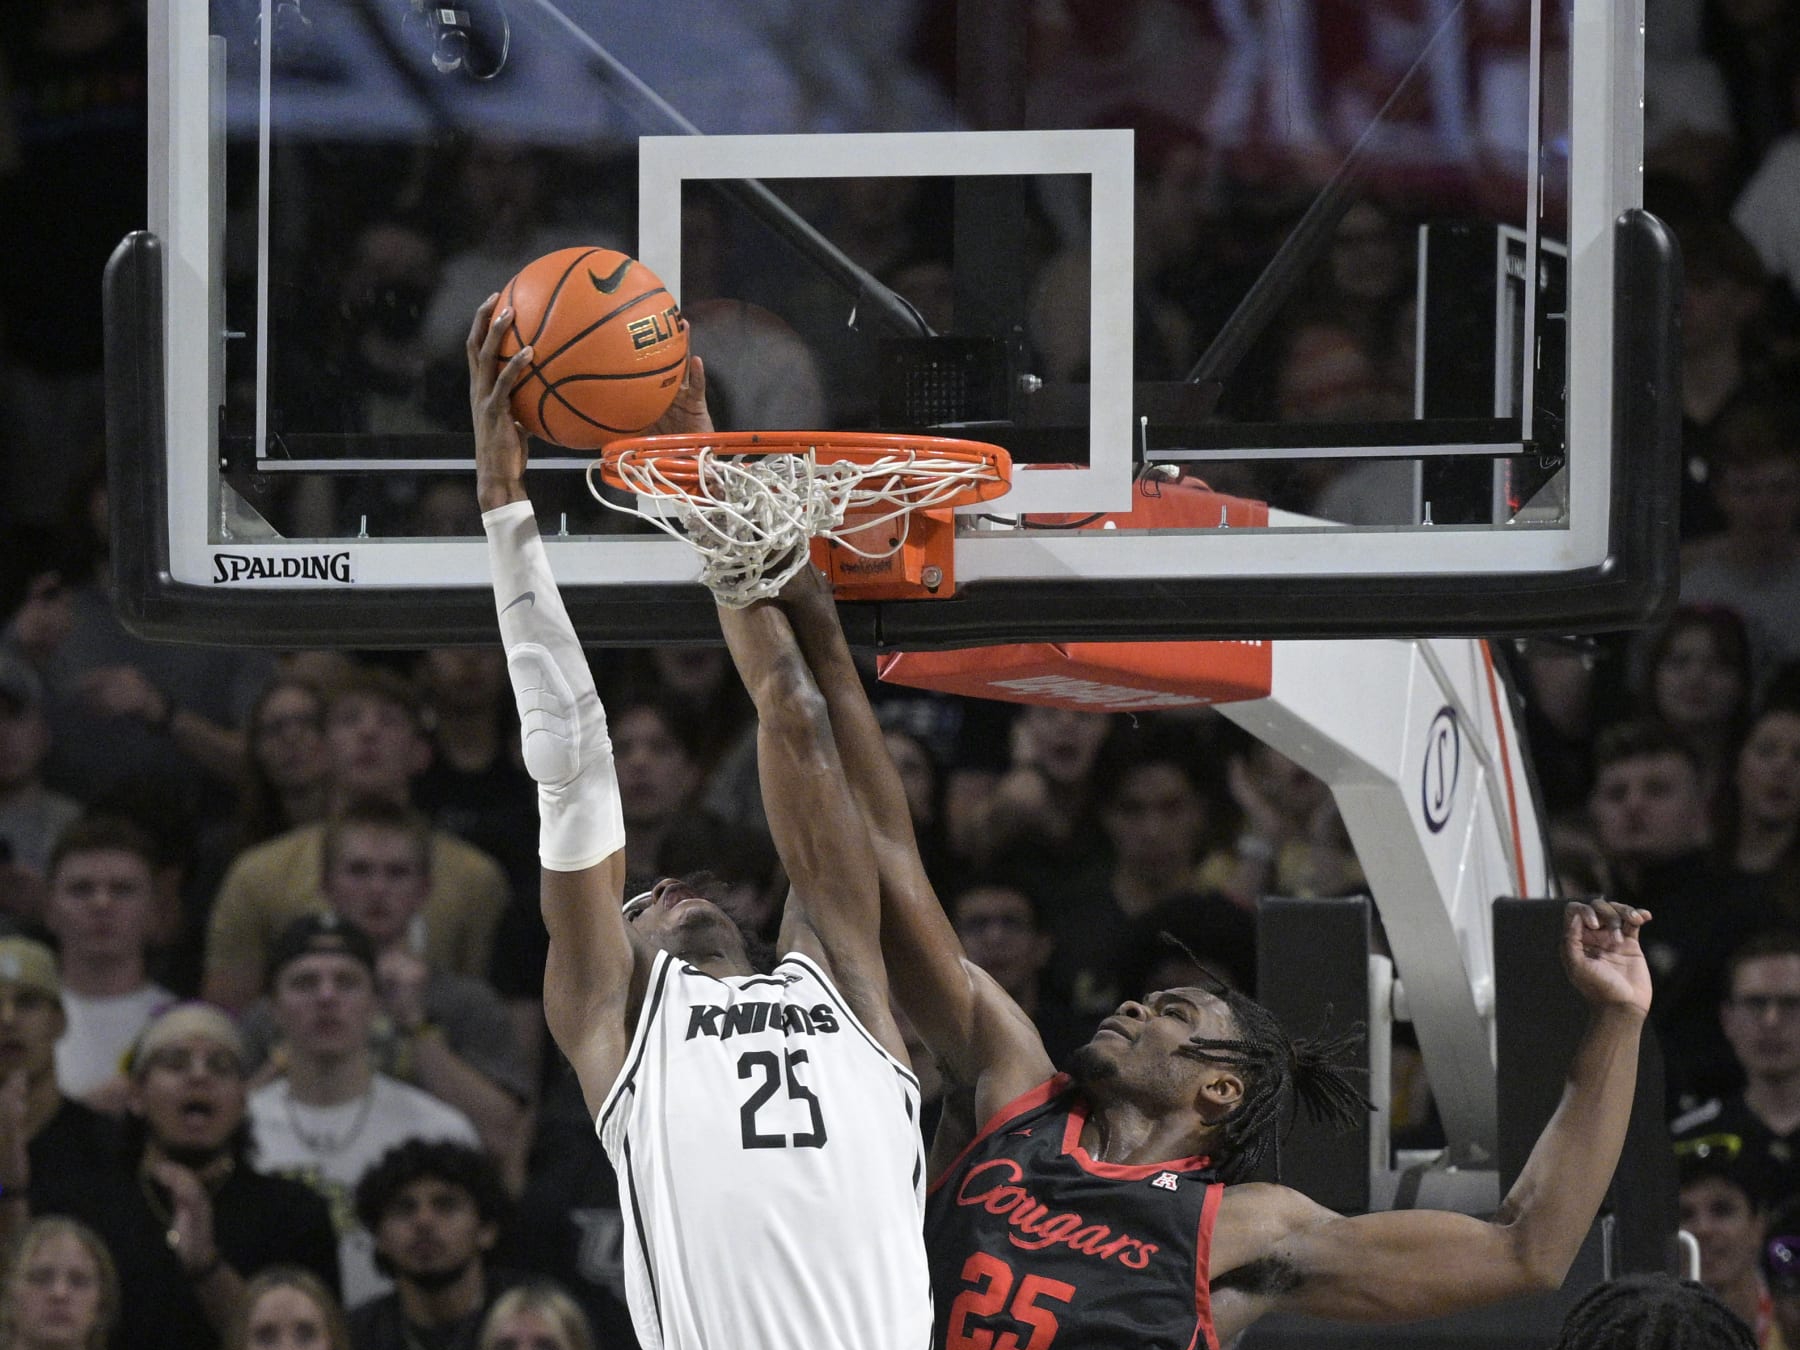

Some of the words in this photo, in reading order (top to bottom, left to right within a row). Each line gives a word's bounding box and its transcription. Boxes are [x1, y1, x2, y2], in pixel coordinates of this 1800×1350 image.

[213, 552, 350, 584] SPALDING
[737, 1047, 828, 1150] 25
[956, 1158, 1160, 1269] Cougars
